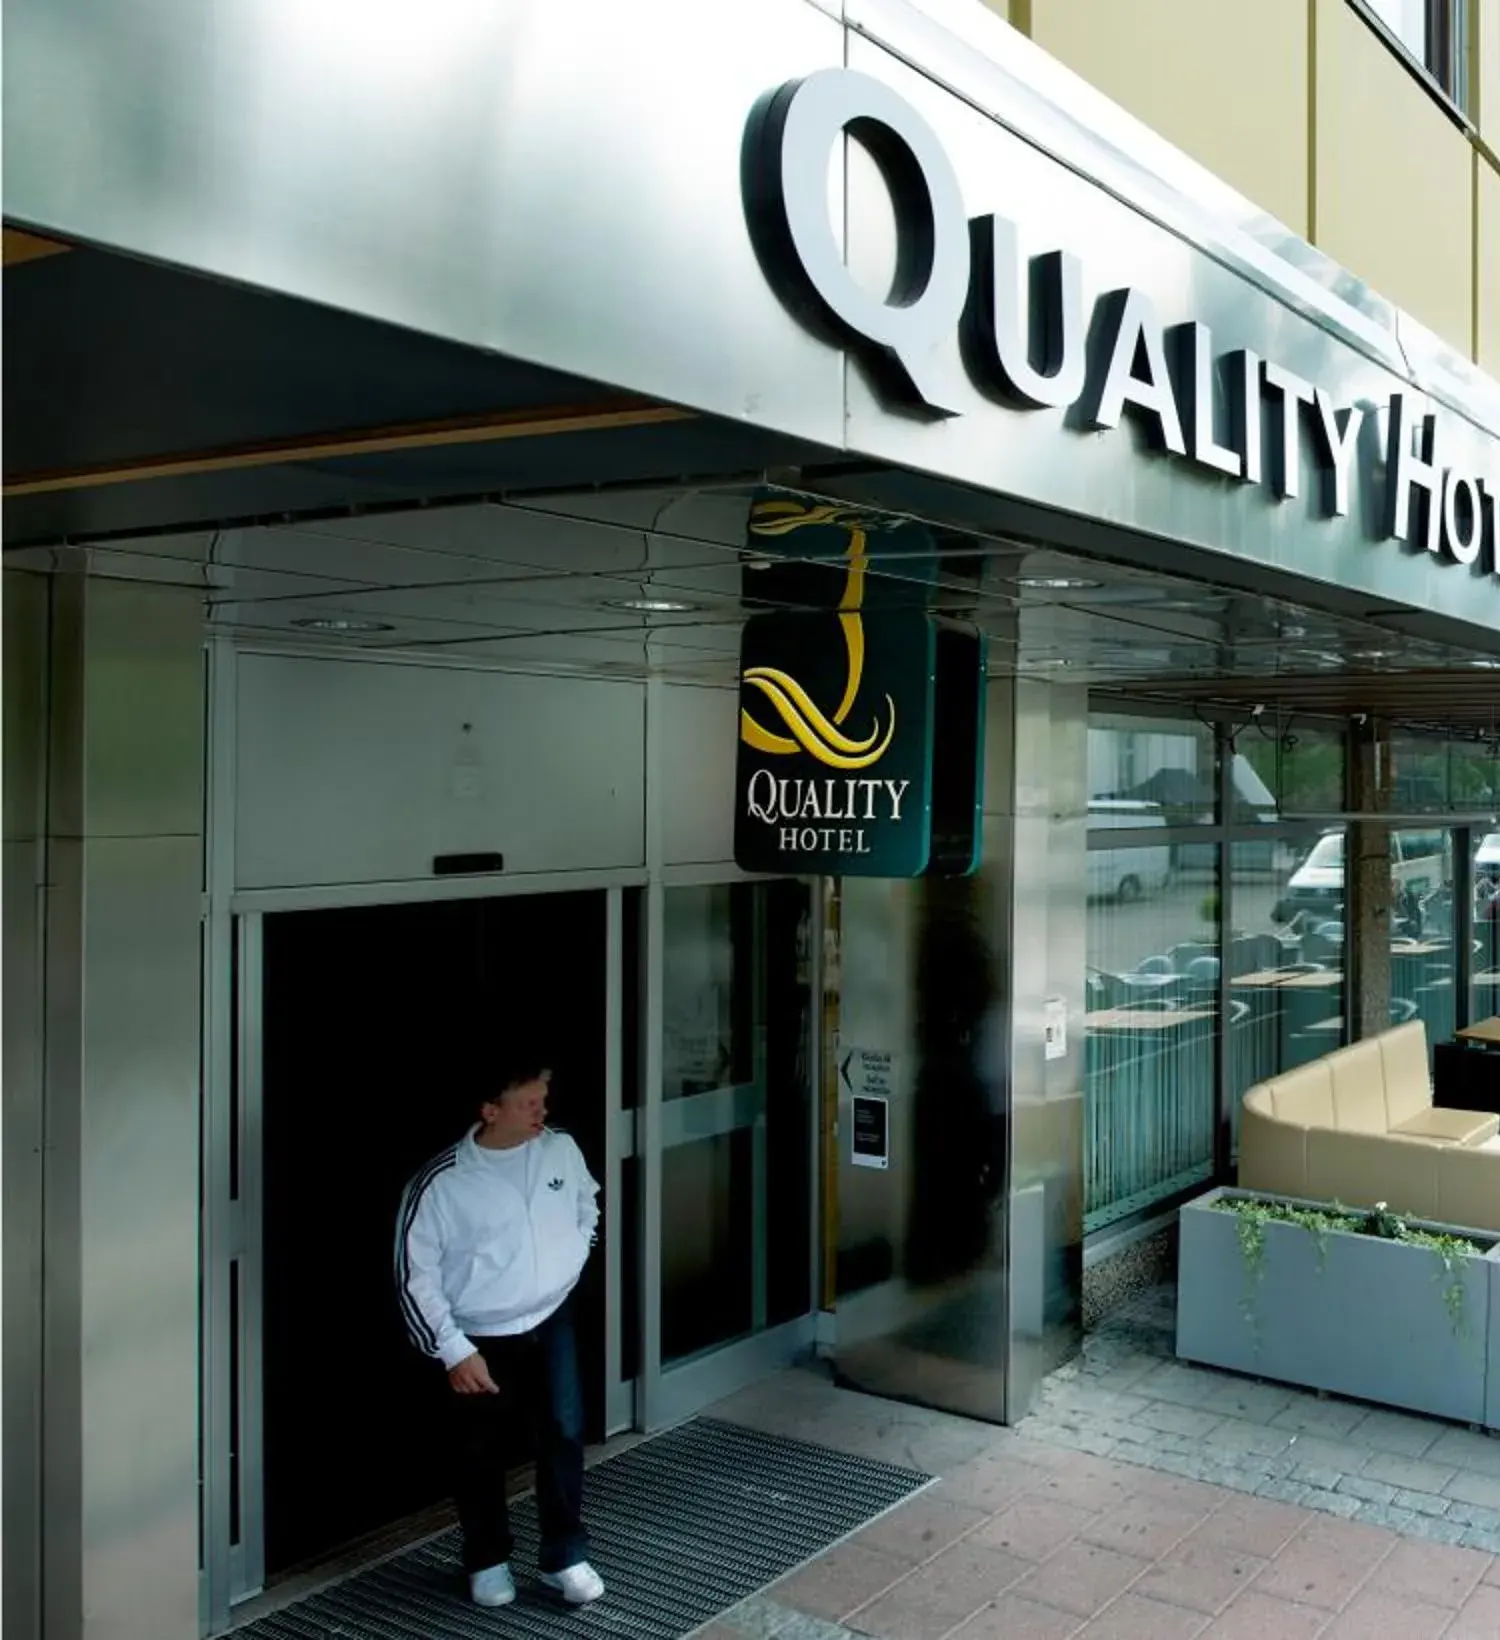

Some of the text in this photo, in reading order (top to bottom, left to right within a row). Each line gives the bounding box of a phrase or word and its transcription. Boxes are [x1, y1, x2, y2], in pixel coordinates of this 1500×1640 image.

[741, 66, 1364, 518] QUALITY
[748, 769, 910, 824] QUALITY
[779, 827, 871, 853] HOTEL
